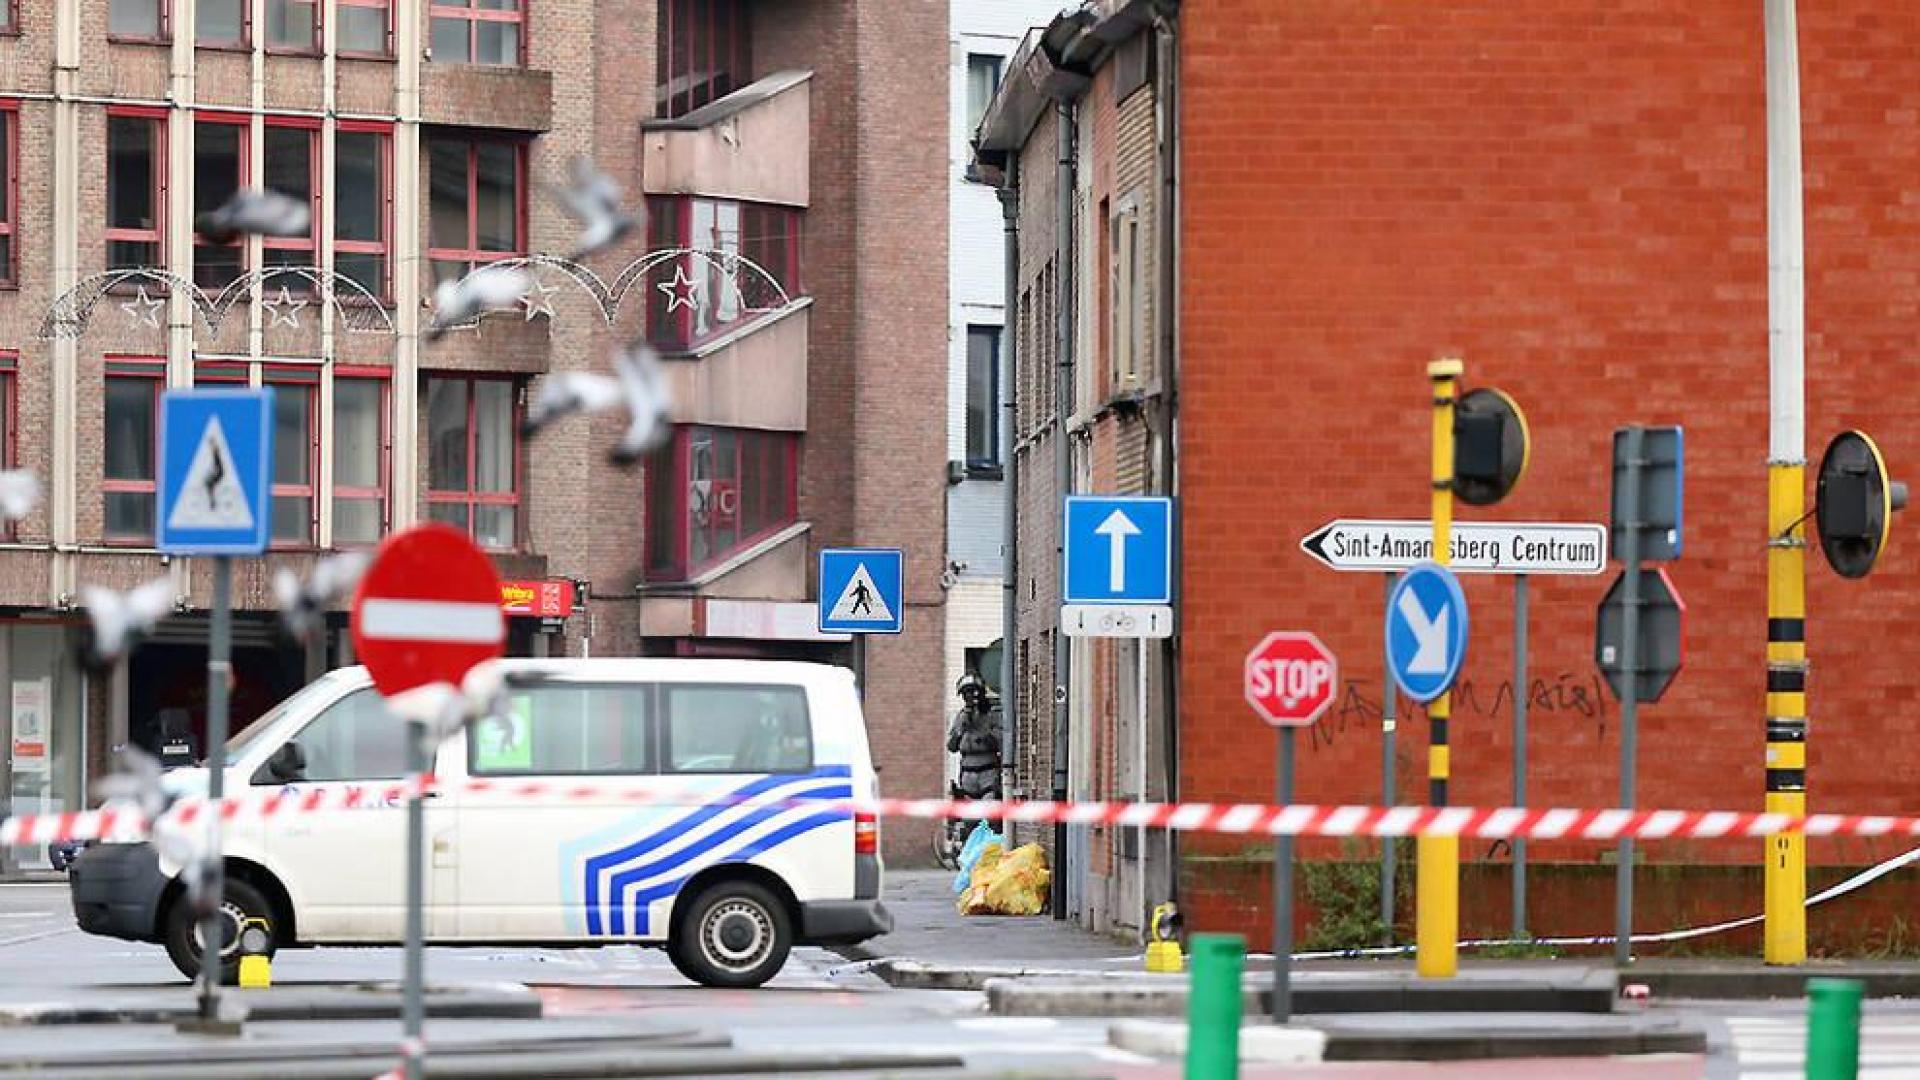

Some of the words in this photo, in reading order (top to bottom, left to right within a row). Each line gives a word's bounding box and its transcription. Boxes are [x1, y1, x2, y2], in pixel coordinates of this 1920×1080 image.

[1333, 531, 1500, 568] Sint-Amansberg
[1512, 534, 1596, 562] Centrum
[1251, 659, 1331, 698] STOP
